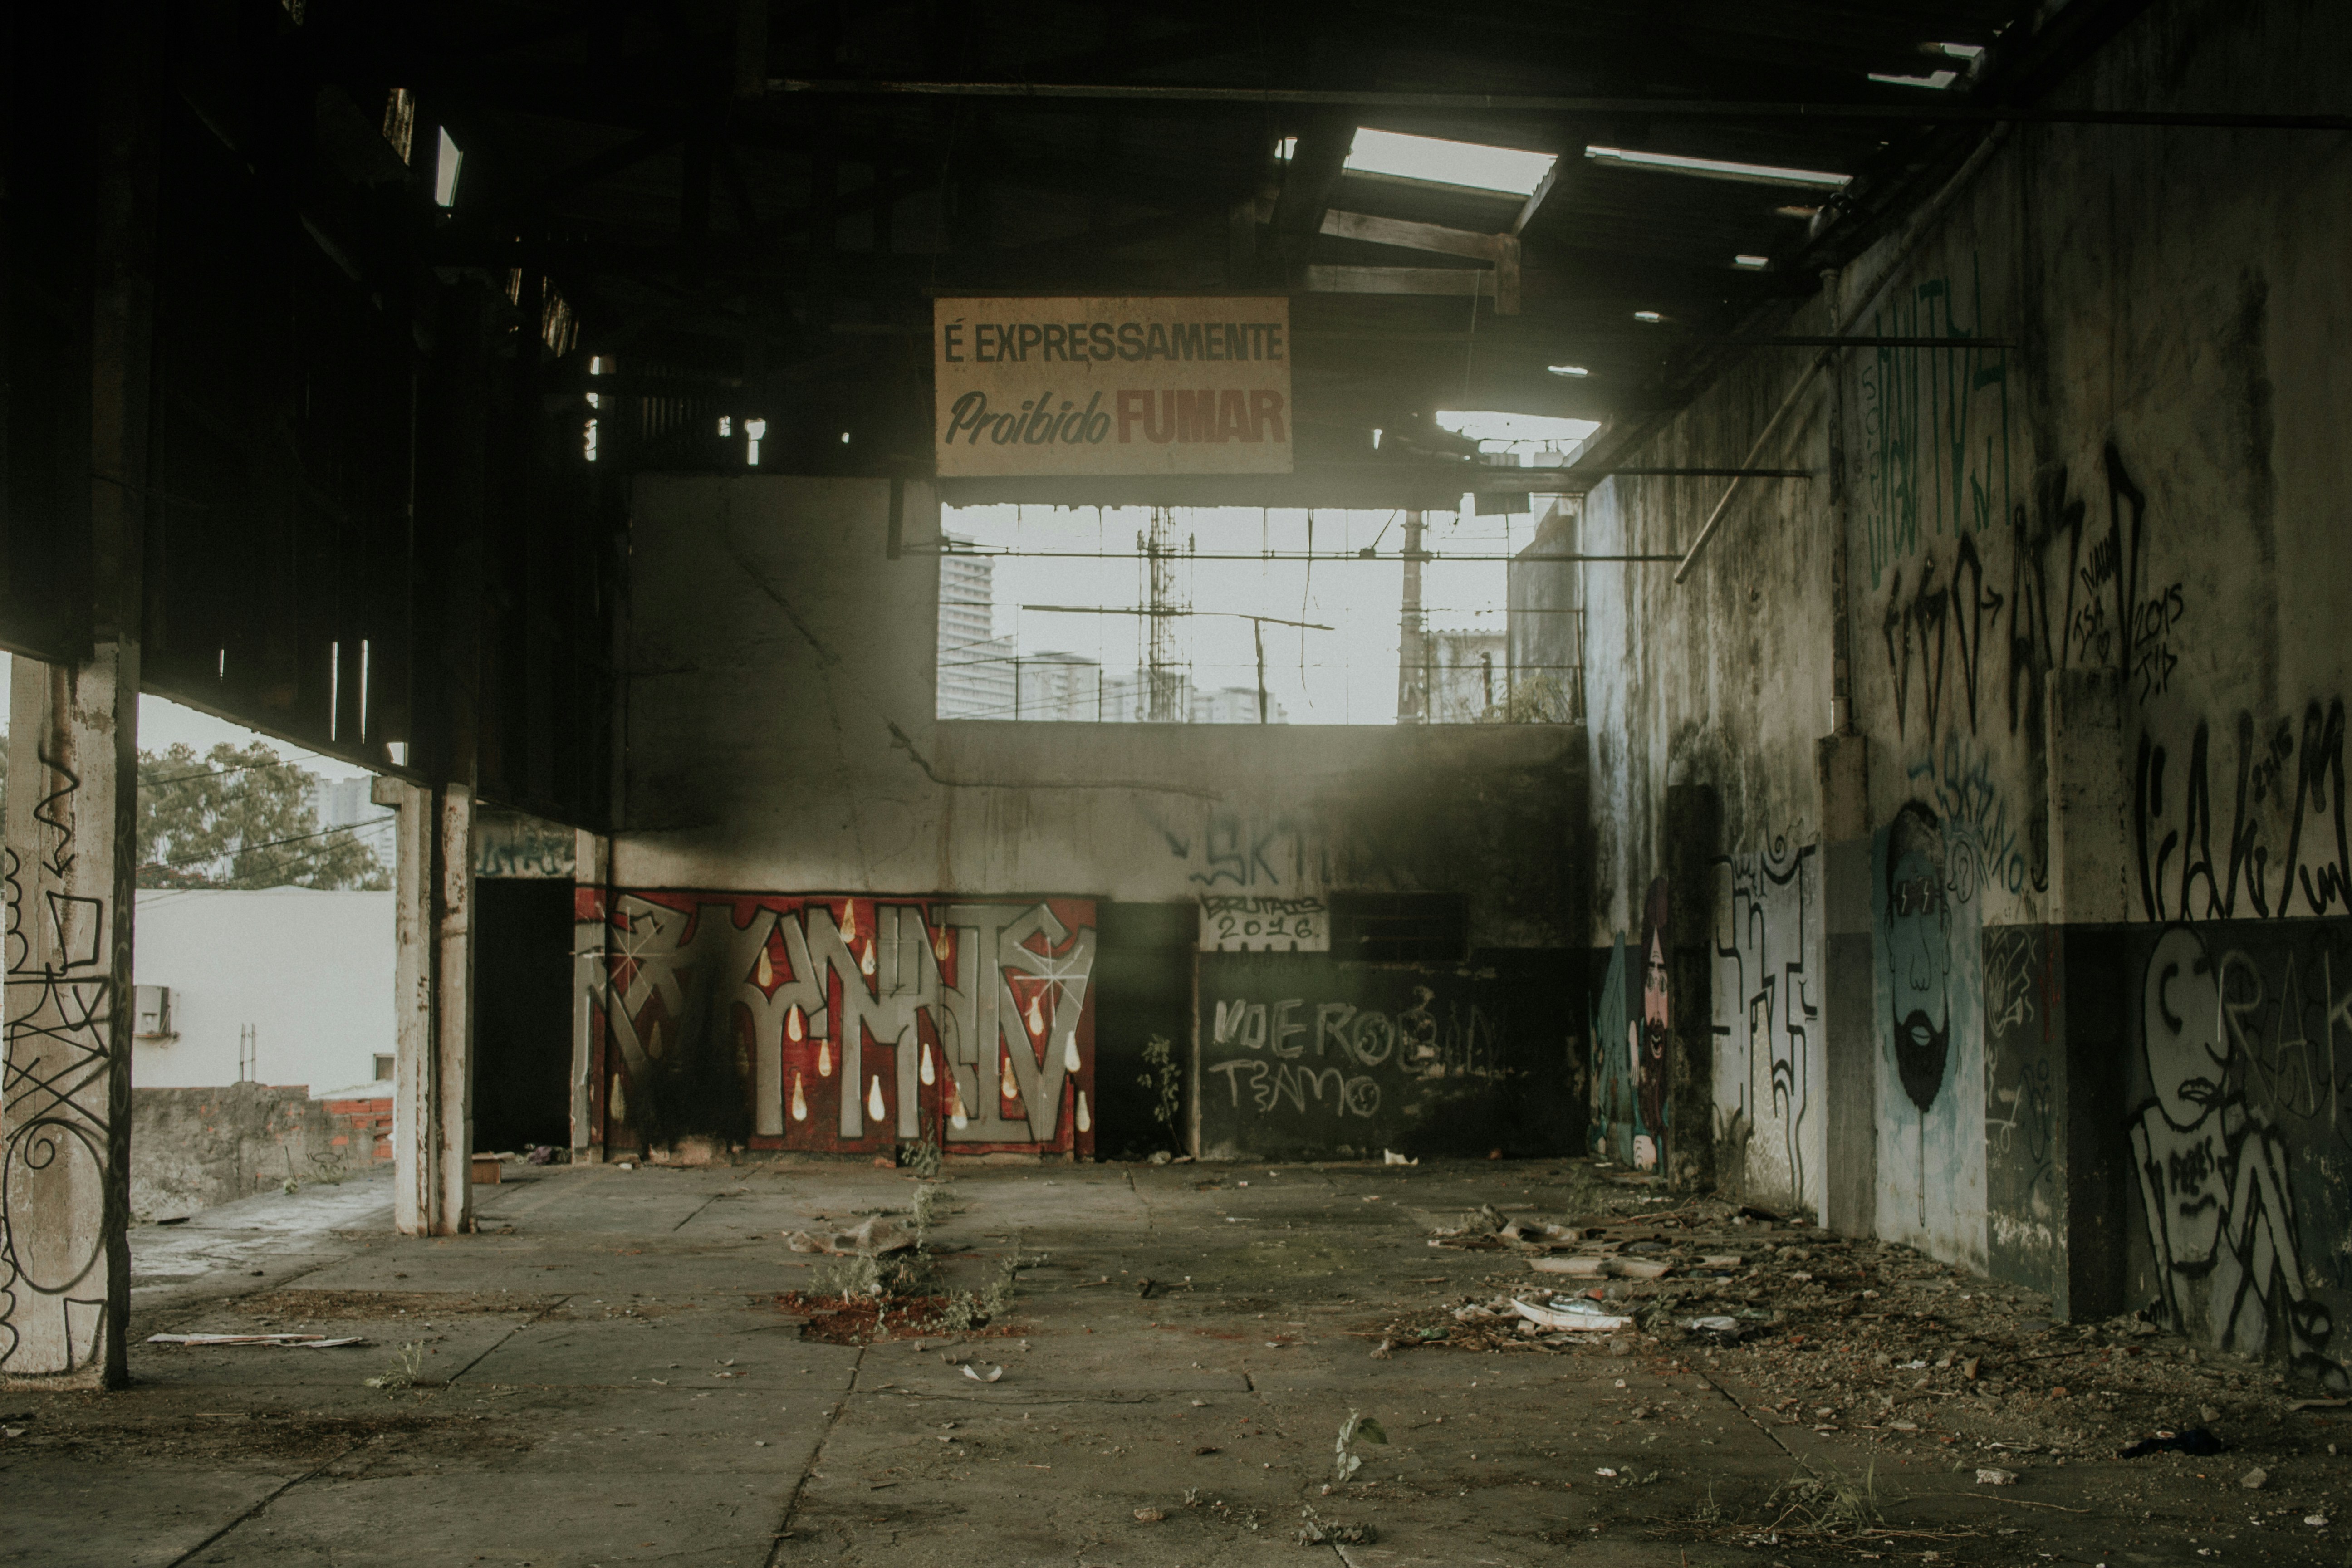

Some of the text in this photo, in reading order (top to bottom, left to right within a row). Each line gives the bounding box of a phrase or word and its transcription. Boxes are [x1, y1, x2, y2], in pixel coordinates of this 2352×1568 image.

[944, 318, 1283, 363] É EXPRESSAMENTE
[945, 389, 1287, 446] Proibido FUMAR
